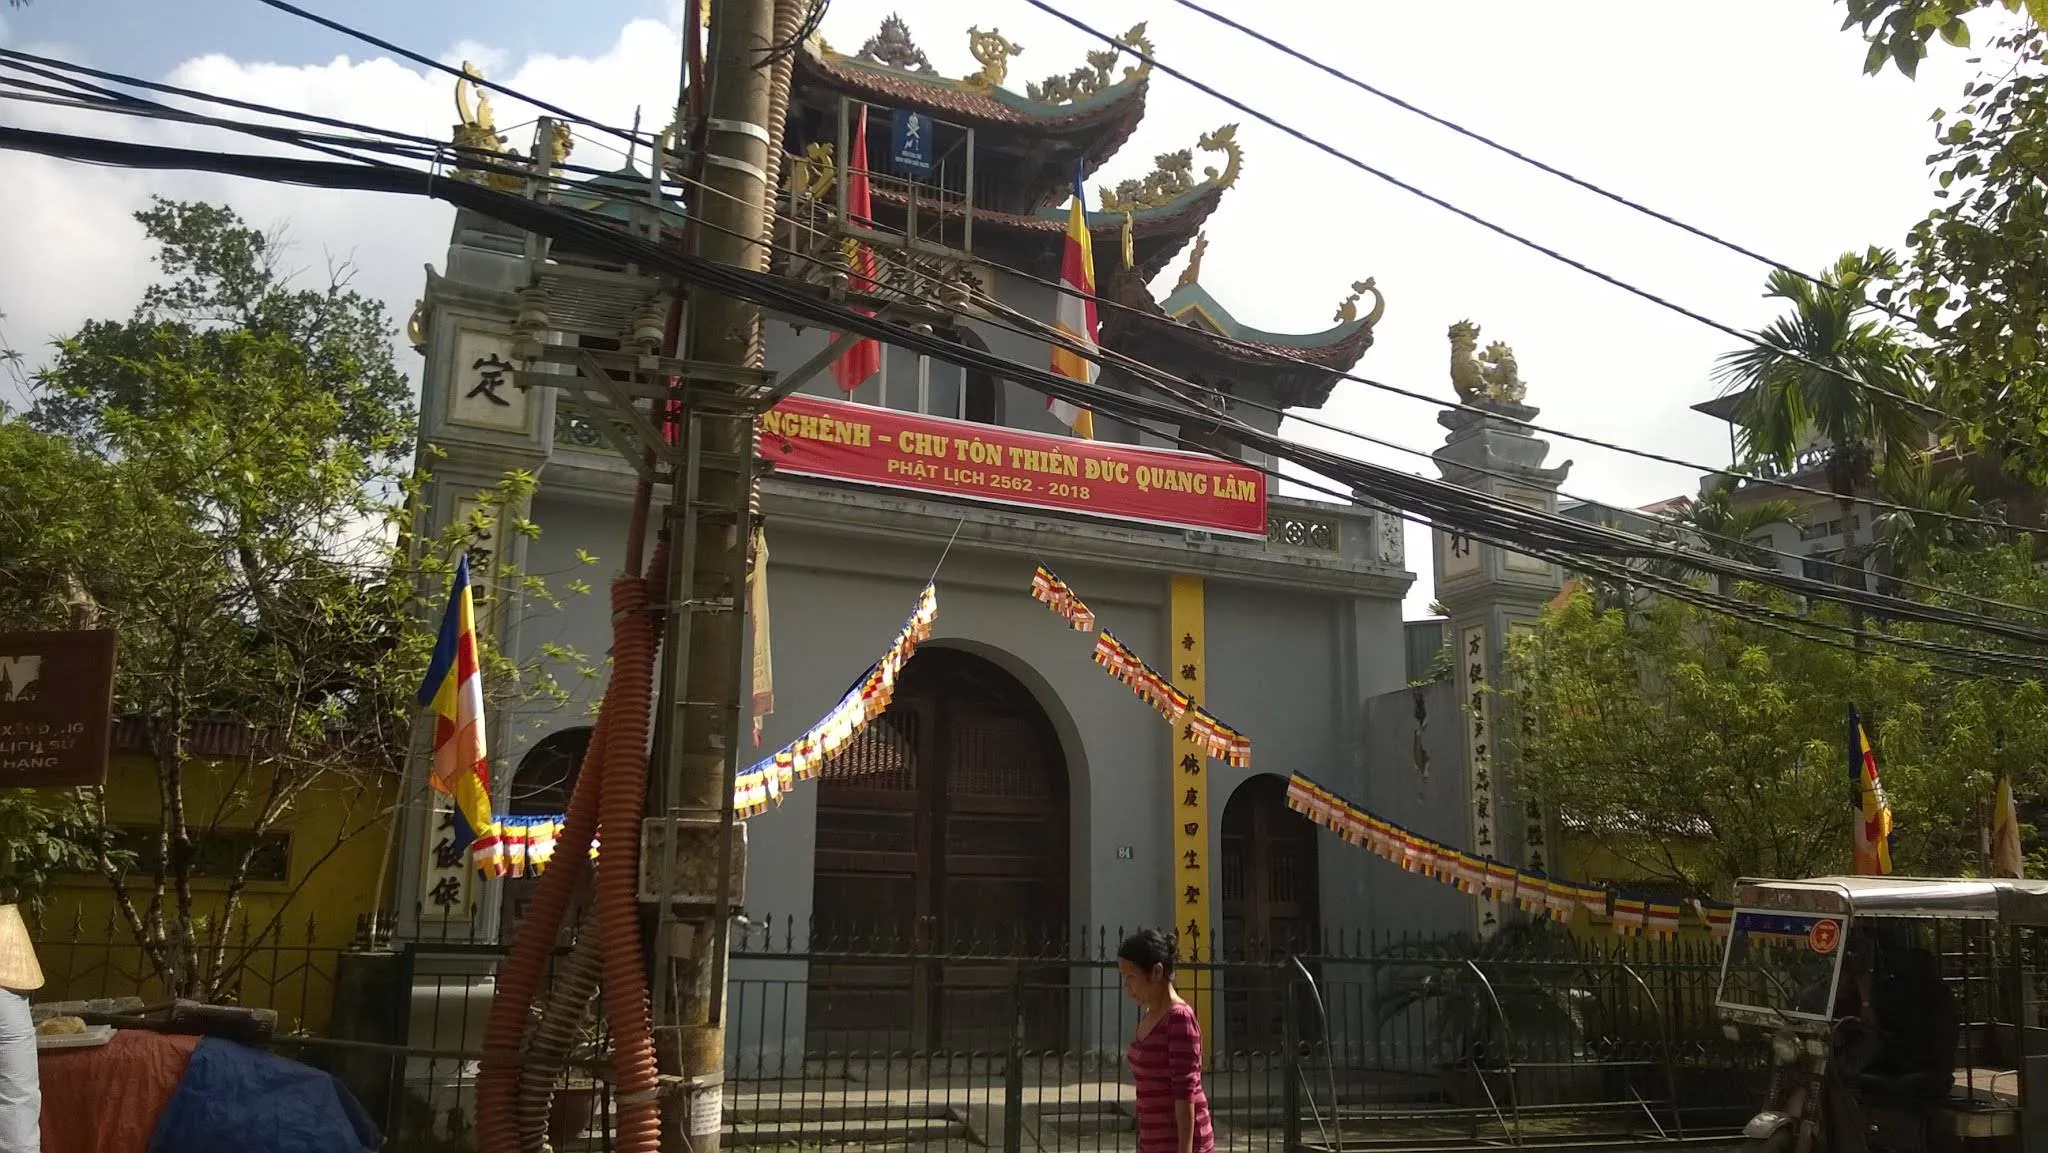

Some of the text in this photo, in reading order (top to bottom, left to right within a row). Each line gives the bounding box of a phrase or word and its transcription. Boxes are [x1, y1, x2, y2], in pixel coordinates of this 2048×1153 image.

[763, 411, 871, 447] NGHÊNH
[899, 430, 949, 458] CHƯ
[955, 437, 1002, 465] TÔN
[1009, 446, 1078, 477] THIỀN
[1085, 457, 1129, 484] ĐỨC
[1136, 466, 1207, 494] QUANG
[1213, 474, 1256, 502] LÂM
[887, 459, 938, 480] PHẬT
[944, 468, 985, 486] LỊCH
[991, 474, 1033, 492] 2562
[1050, 482, 1090, 500] 2018
